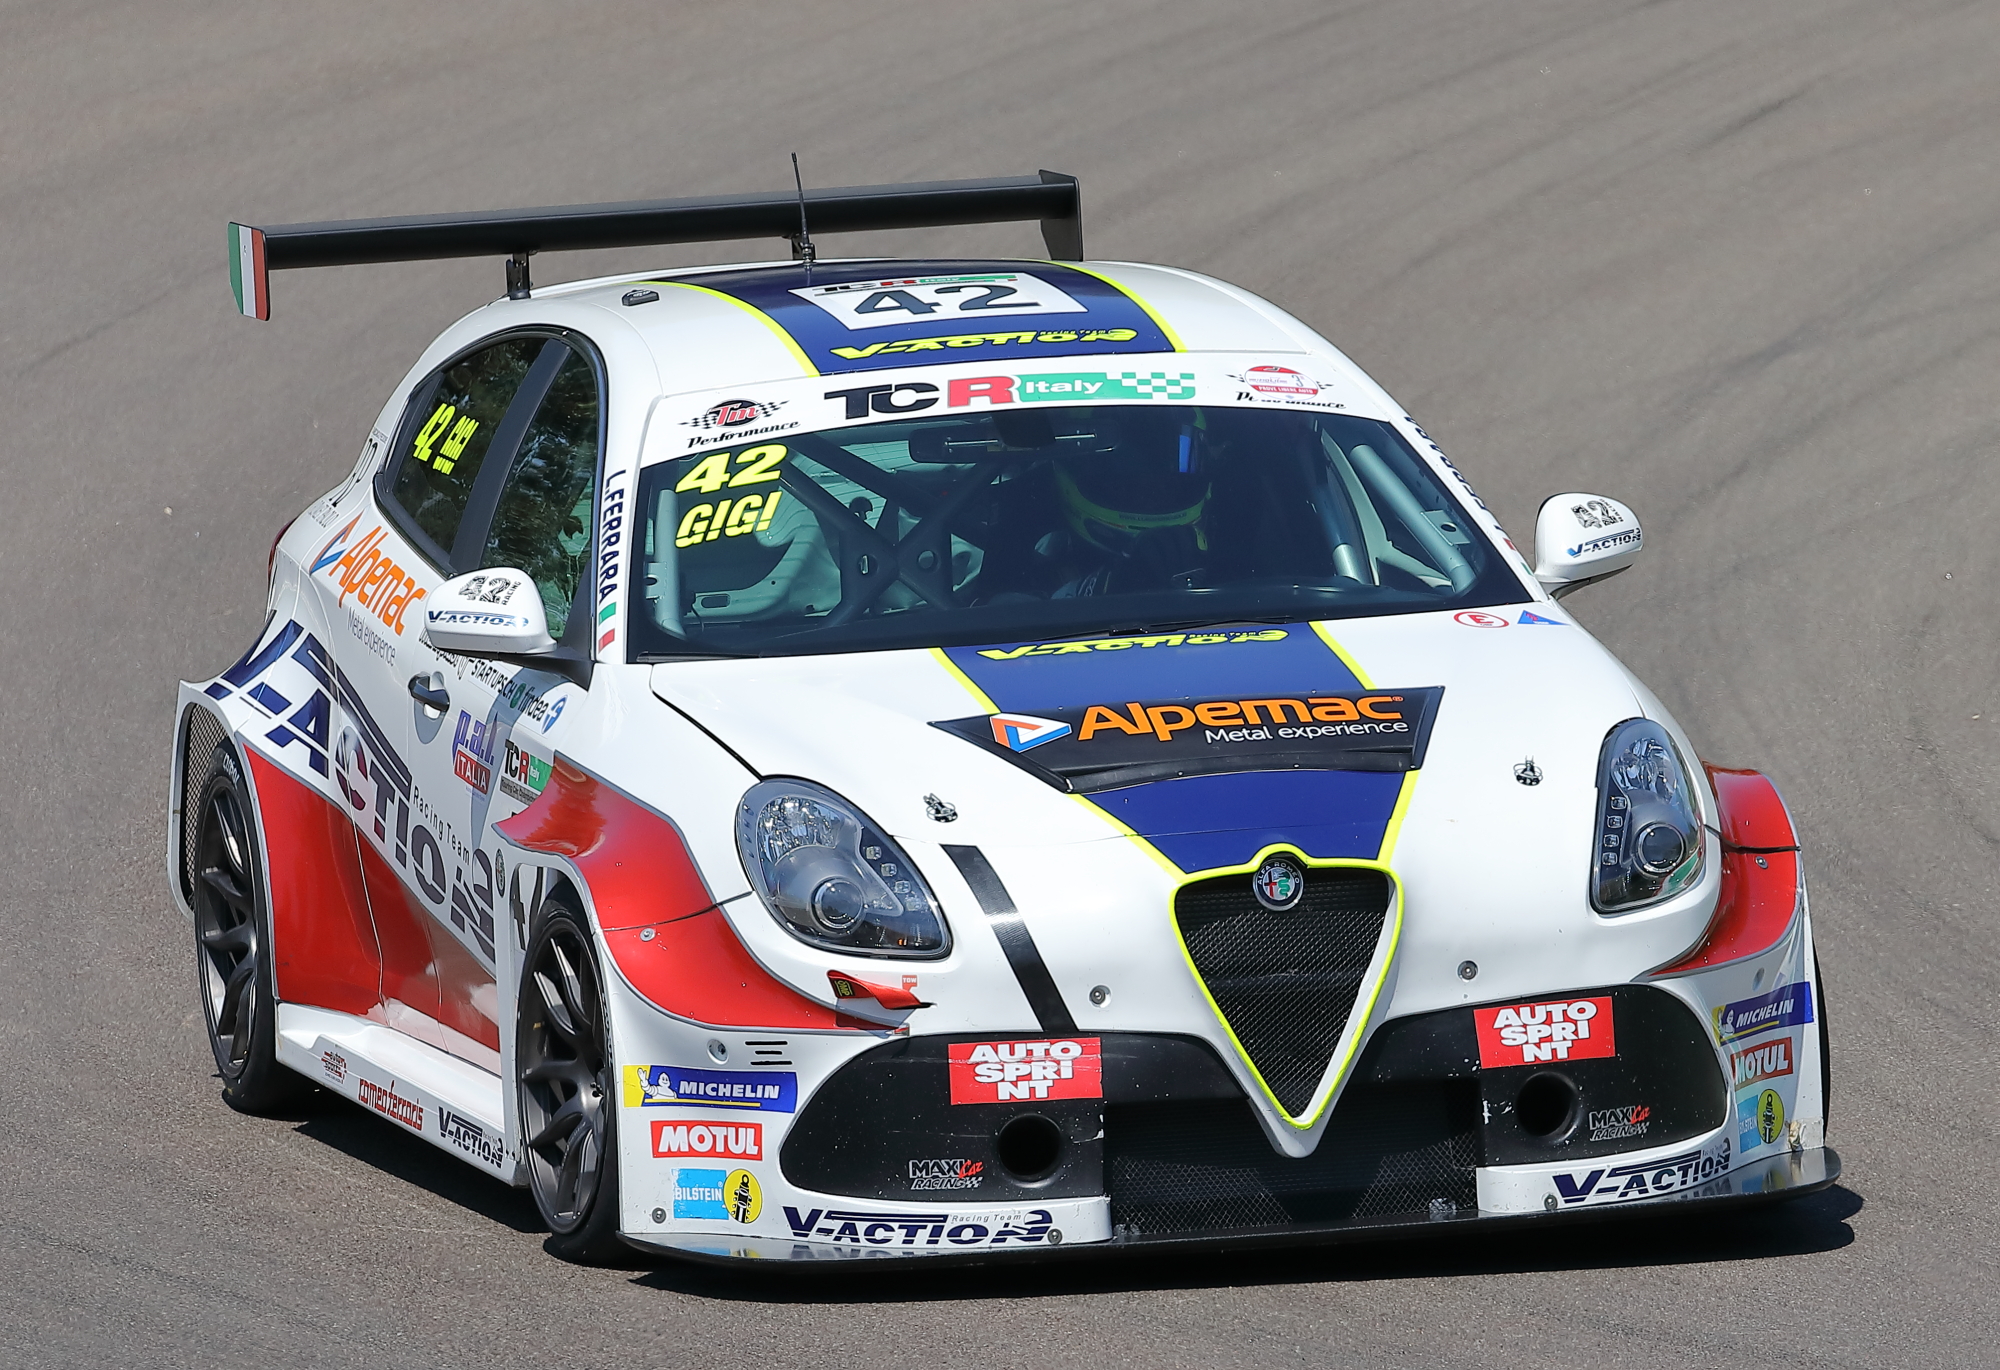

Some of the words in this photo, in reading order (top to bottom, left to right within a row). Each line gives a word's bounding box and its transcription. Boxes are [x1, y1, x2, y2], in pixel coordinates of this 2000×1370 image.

[854, 285, 1042, 315] 42
[824, 375, 1015, 420] TCR
[1025, 379, 1104, 395] Italy
[413, 402, 456, 462] 42
[687, 421, 800, 448] Performance
[674, 444, 788, 494] 42
[675, 491, 783, 548] GIGI
[1570, 500, 1619, 529] 42
[599, 469, 627, 605] L.FERRARA
[328, 525, 427, 637] Alpemac
[458, 575, 512, 605] 42
[501, 581, 522, 606] RACING
[347, 605, 364, 642] Metal
[364, 631, 396, 667] experience
[1078, 696, 1402, 741] Alpemac
[1205, 726, 1273, 744] Metal
[1278, 722, 1409, 739] experience
[456, 754, 487, 791] ITALIA
[504, 739, 529, 785] TCR
[413, 786, 443, 842] Racing
[446, 823, 470, 866] Team
[1257, 864, 1271, 885] ALFA
[1274, 861, 1300, 884] ROMEO
[838, 980, 850, 996] OMP
[1493, 1001, 1598, 1028] AUTO
[1736, 997, 1794, 1028] MICHELIN
[1500, 1020, 1590, 1046] SPRI
[969, 1041, 1082, 1064] AUTO
[1522, 1040, 1572, 1062] NT
[1735, 1043, 1789, 1085] MOTUL
[974, 1060, 1073, 1083] SPRI
[679, 1081, 780, 1099] MICHELIN
[997, 1080, 1054, 1100] NT
[1589, 1106, 1635, 1130] MAXI
[1631, 1105, 1650, 1124] Car
[658, 1125, 759, 1155] MOTUL
[1590, 1123, 1637, 1141] RACING
[909, 1160, 964, 1178] MAXI
[958, 1160, 983, 1179] Car
[674, 1187, 722, 1201] BILSTEIN
[911, 1178, 965, 1190] RACING
[951, 1214, 990, 1224] Racing
[994, 1213, 1022, 1222] Team
